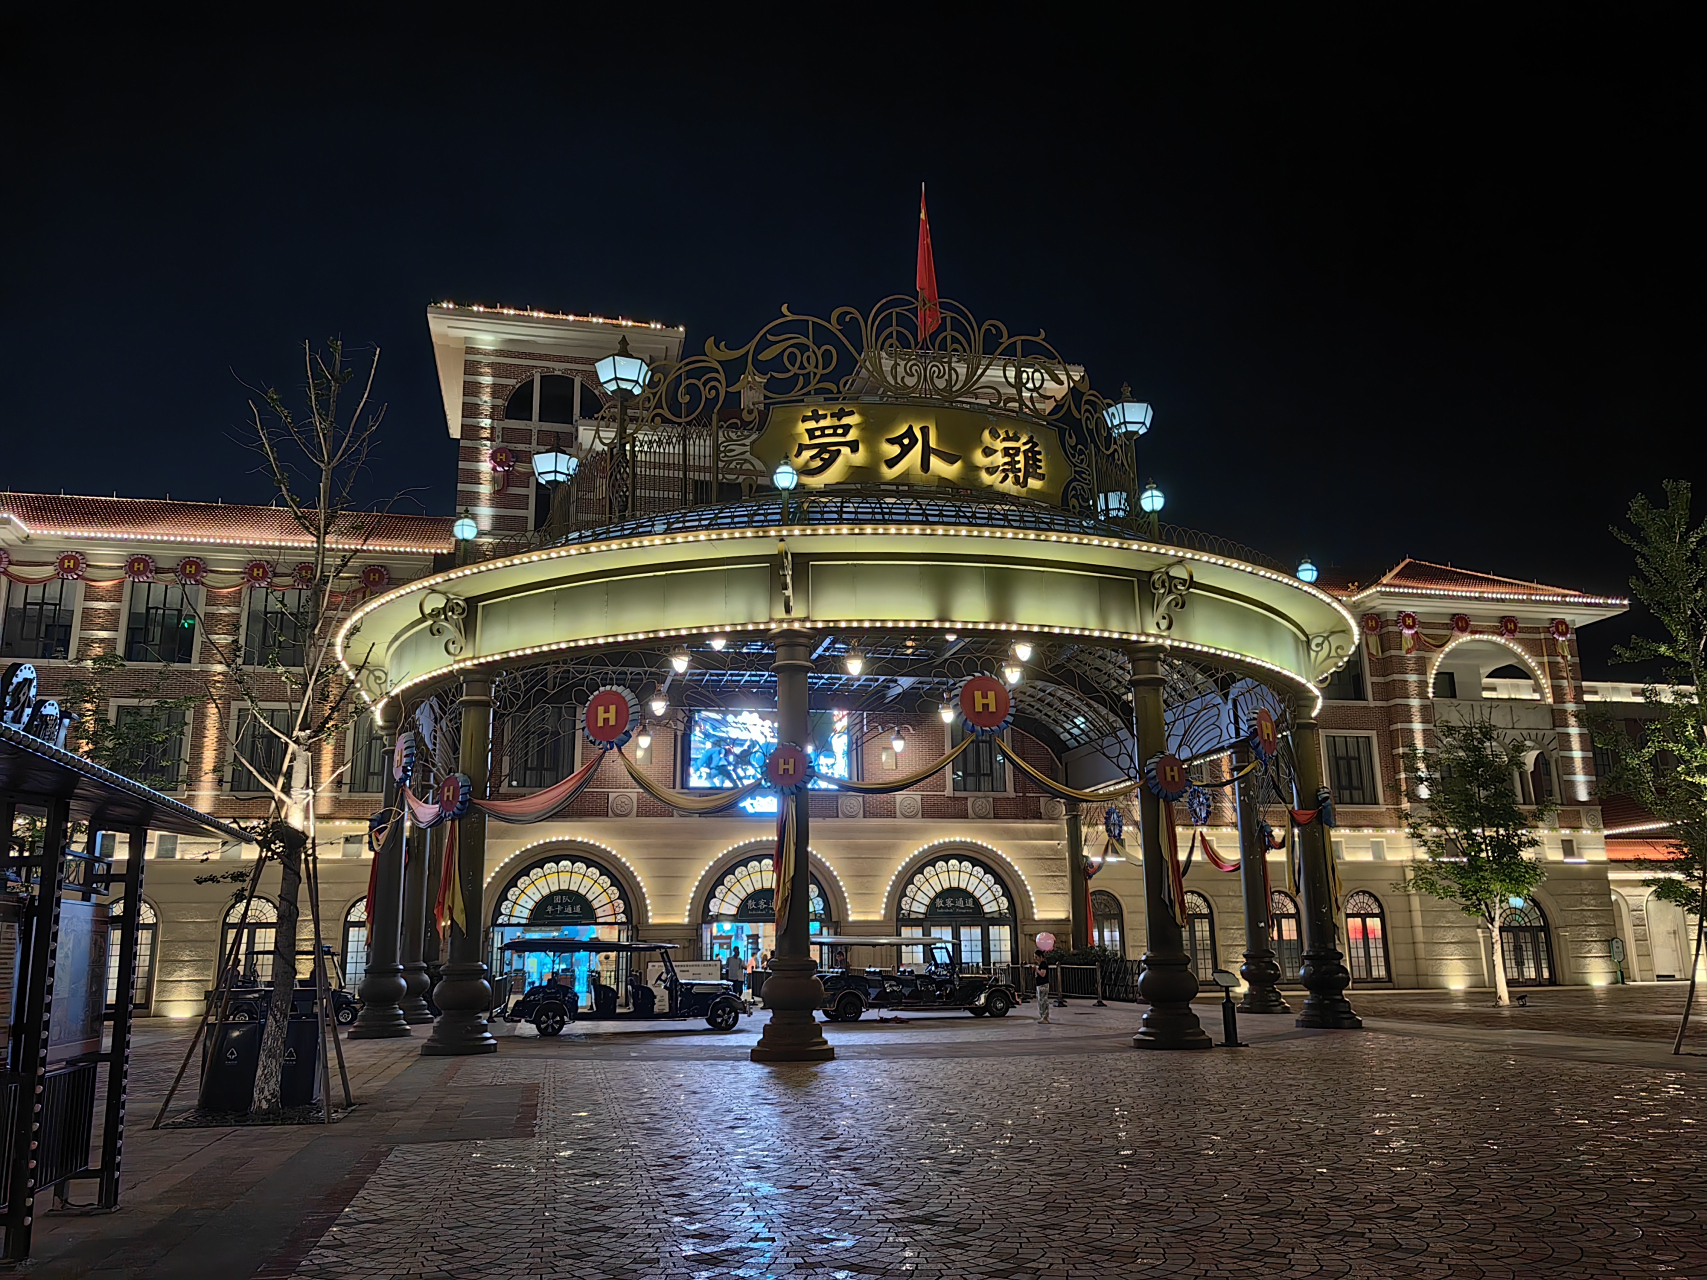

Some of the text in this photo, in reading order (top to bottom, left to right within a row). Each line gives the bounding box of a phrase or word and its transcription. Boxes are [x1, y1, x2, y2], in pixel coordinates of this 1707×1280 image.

[793, 406, 1046, 489] 夢外灘
[496, 452, 506, 462] H
[64, 559, 74, 569] H
[133, 562, 144, 571] H
[185, 564, 196, 574] H
[253, 567, 263, 577] H
[370, 572, 379, 582] H
[1368, 619, 1376, 627] H
[1405, 617, 1413, 626] H
[1507, 622, 1515, 630] H
[1558, 624, 1566, 632] H
[974, 690, 997, 712] H
[597, 704, 617, 727] H
[1261, 720, 1273, 742] H
[395, 748, 403, 768] H
[778, 758, 796, 775] H
[1164, 765, 1179, 782] H
[443, 785, 454, 801] H
[934, 897, 975, 908] 散客通道
